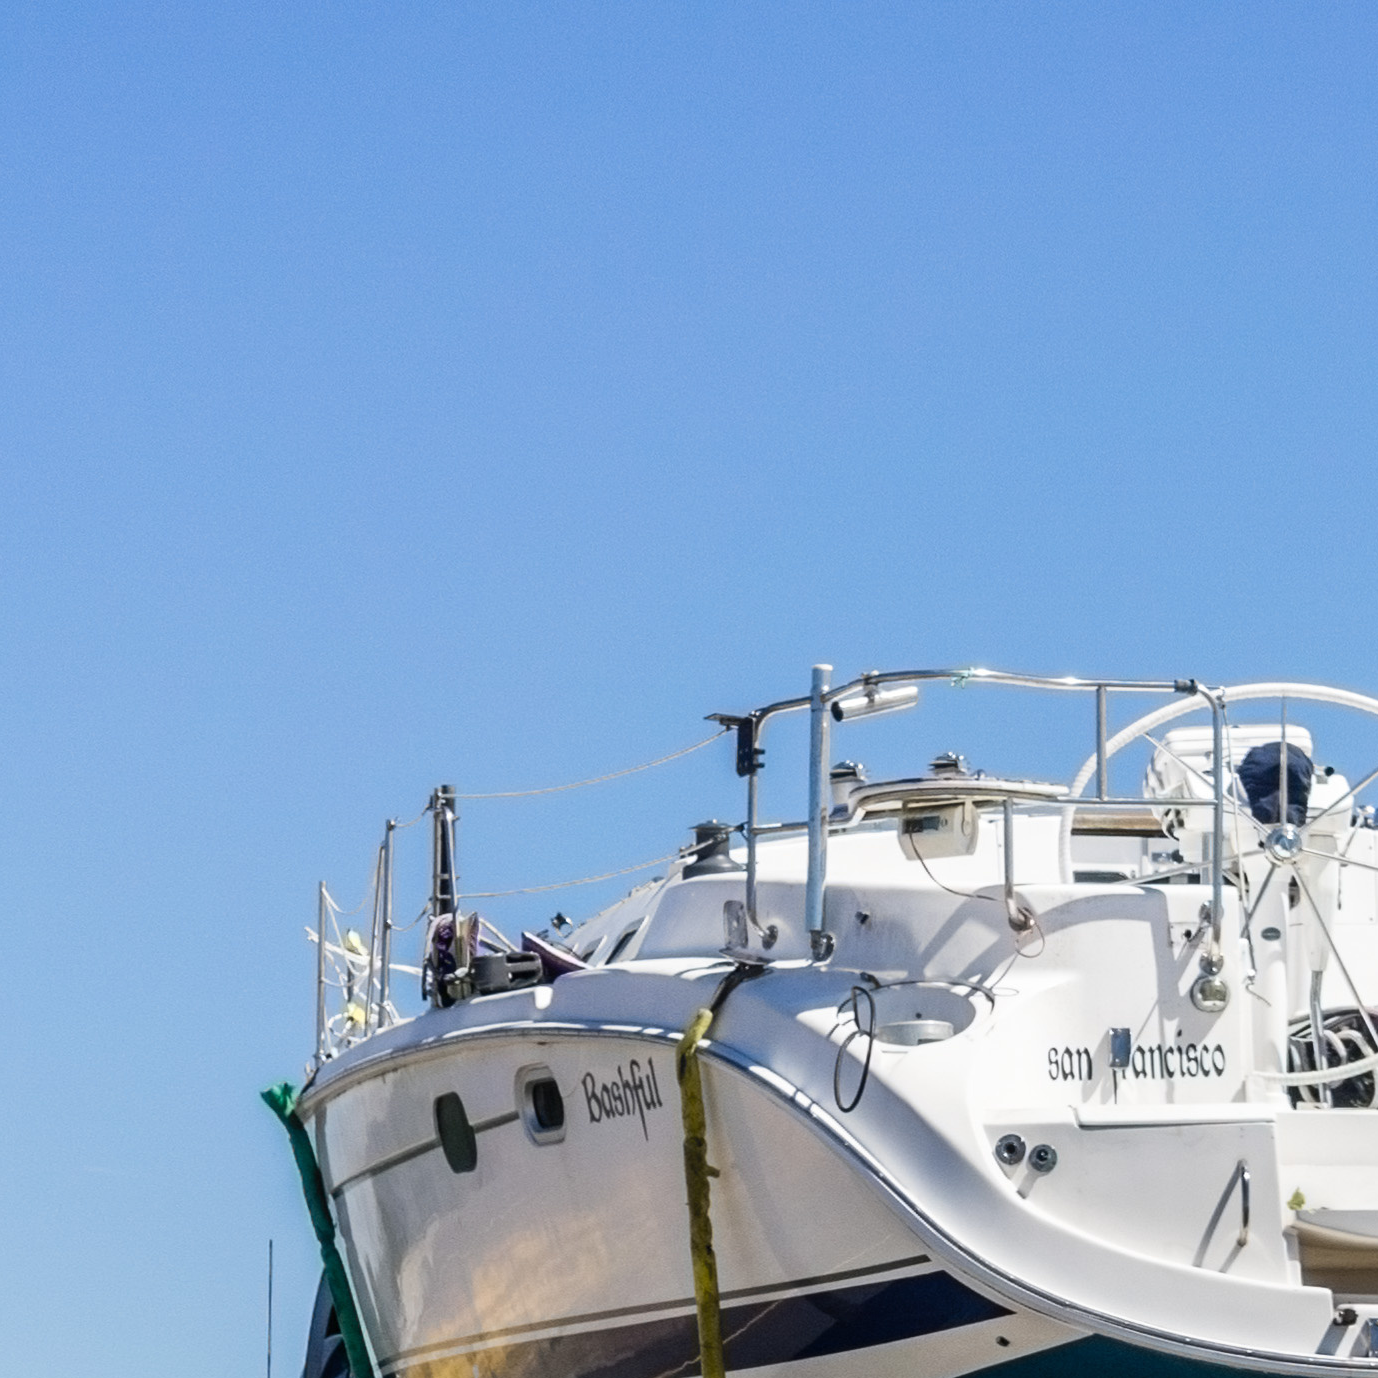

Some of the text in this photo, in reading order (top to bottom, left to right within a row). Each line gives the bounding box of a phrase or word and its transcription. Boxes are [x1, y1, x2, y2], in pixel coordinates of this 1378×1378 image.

[581, 1056, 663, 1141] Bashful
[1048, 1029, 1225, 1104] san ancisco
